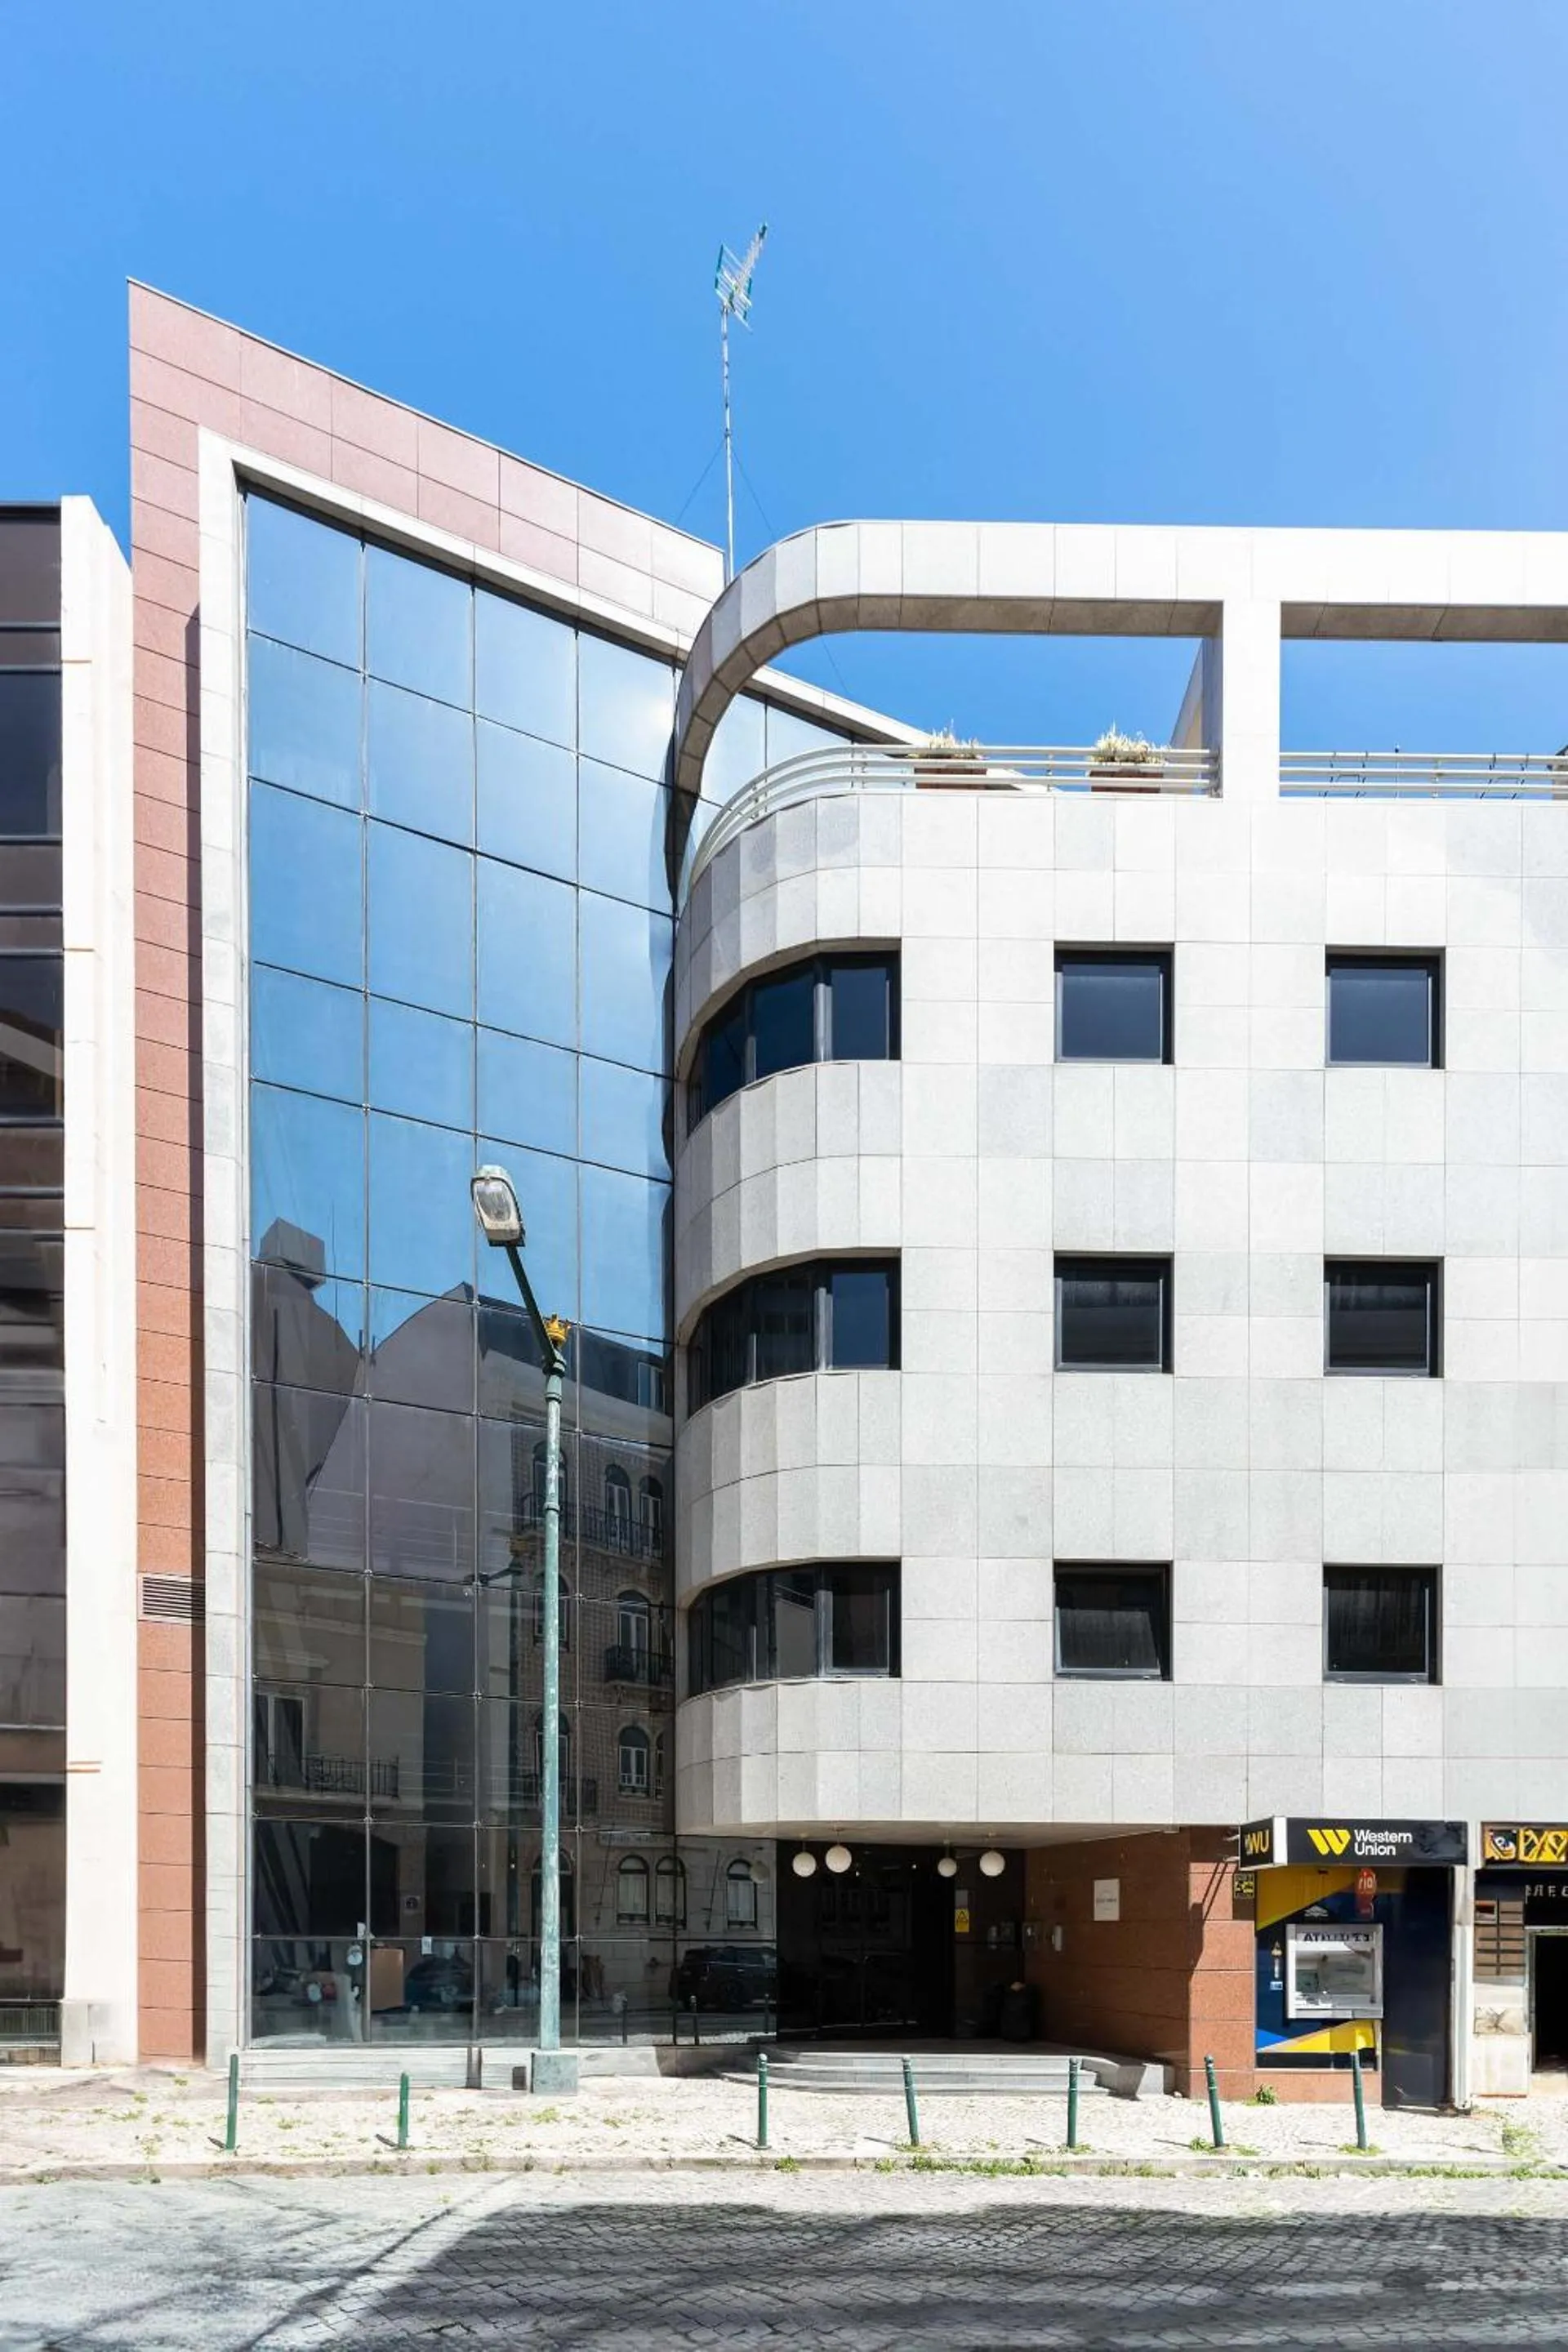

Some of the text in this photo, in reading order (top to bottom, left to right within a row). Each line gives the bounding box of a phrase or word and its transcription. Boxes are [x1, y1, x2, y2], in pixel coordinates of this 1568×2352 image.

[1245, 1829, 1270, 1855] WU
[1354, 1829, 1413, 1843] Western
[1354, 1842, 1396, 1855] Union
